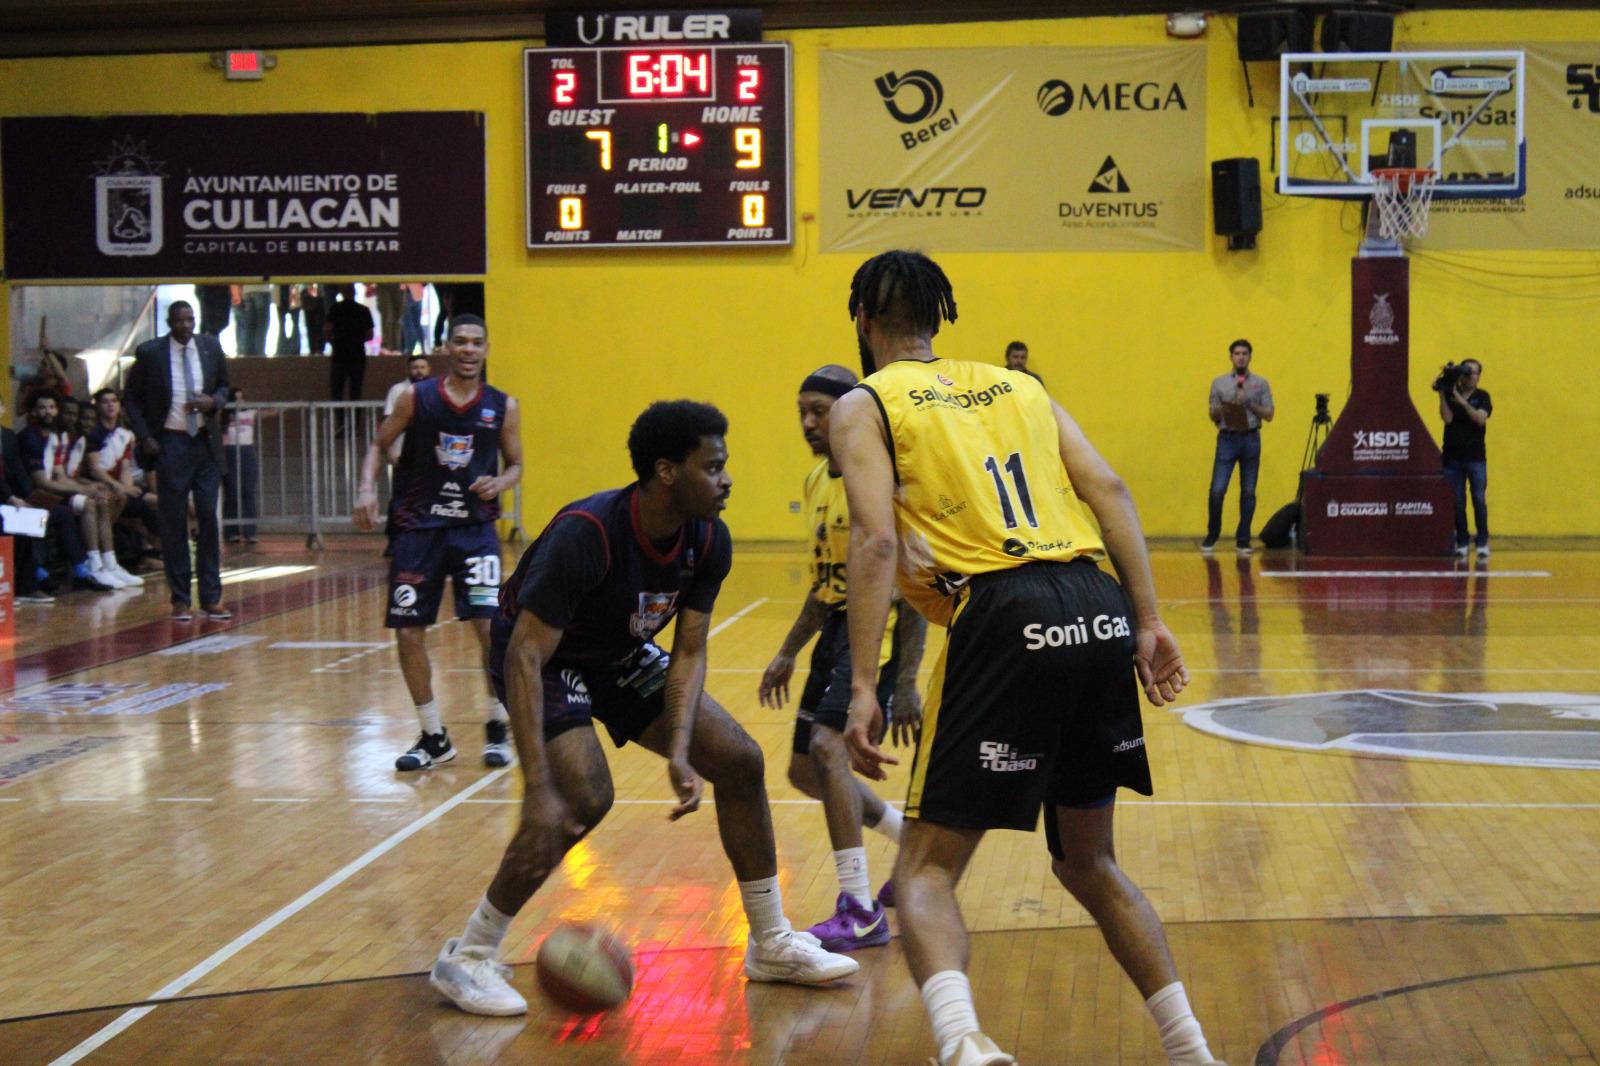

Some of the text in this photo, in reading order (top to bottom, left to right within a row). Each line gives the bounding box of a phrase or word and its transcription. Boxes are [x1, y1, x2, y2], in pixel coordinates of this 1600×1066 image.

[614, 14, 730, 41] RULER
[551, 58, 575, 69] TOL
[736, 55, 760, 66] TOL
[629, 54, 707, 94] 6:04
[739, 69, 758, 100] 2
[555, 73, 575, 103] 2
[1078, 82, 1187, 111] MEGA
[548, 109, 616, 126] GUEST
[702, 106, 763, 123] HOME
[658, 123, 668, 153] 1
[900, 109, 960, 151] Berel
[586, 131, 612, 170] 7
[734, 128, 762, 168] 9
[627, 157, 688, 171] PERIOD
[184, 174, 398, 193] AYUNTAMIENTO DE
[546, 184, 588, 195] FOULS
[614, 182, 702, 194] PLAYER-FOUL
[729, 181, 770, 192] FOULS
[847, 187, 987, 209] VENTO
[183, 193, 399, 230] CULIACÁN
[560, 198, 582, 229] 0
[743, 195, 765, 226] 0
[544, 230, 591, 242] POINTS
[616, 230, 662, 241] MATCH
[727, 228, 773, 239] POINTS
[183, 240, 399, 254] CAPITAL DE BIENESTAR
[1368, 431, 1410, 447] ISDE
[985, 452, 1039, 529] 11
[465, 555, 500, 587] 30
[1022, 614, 1131, 650] Soni Gas
